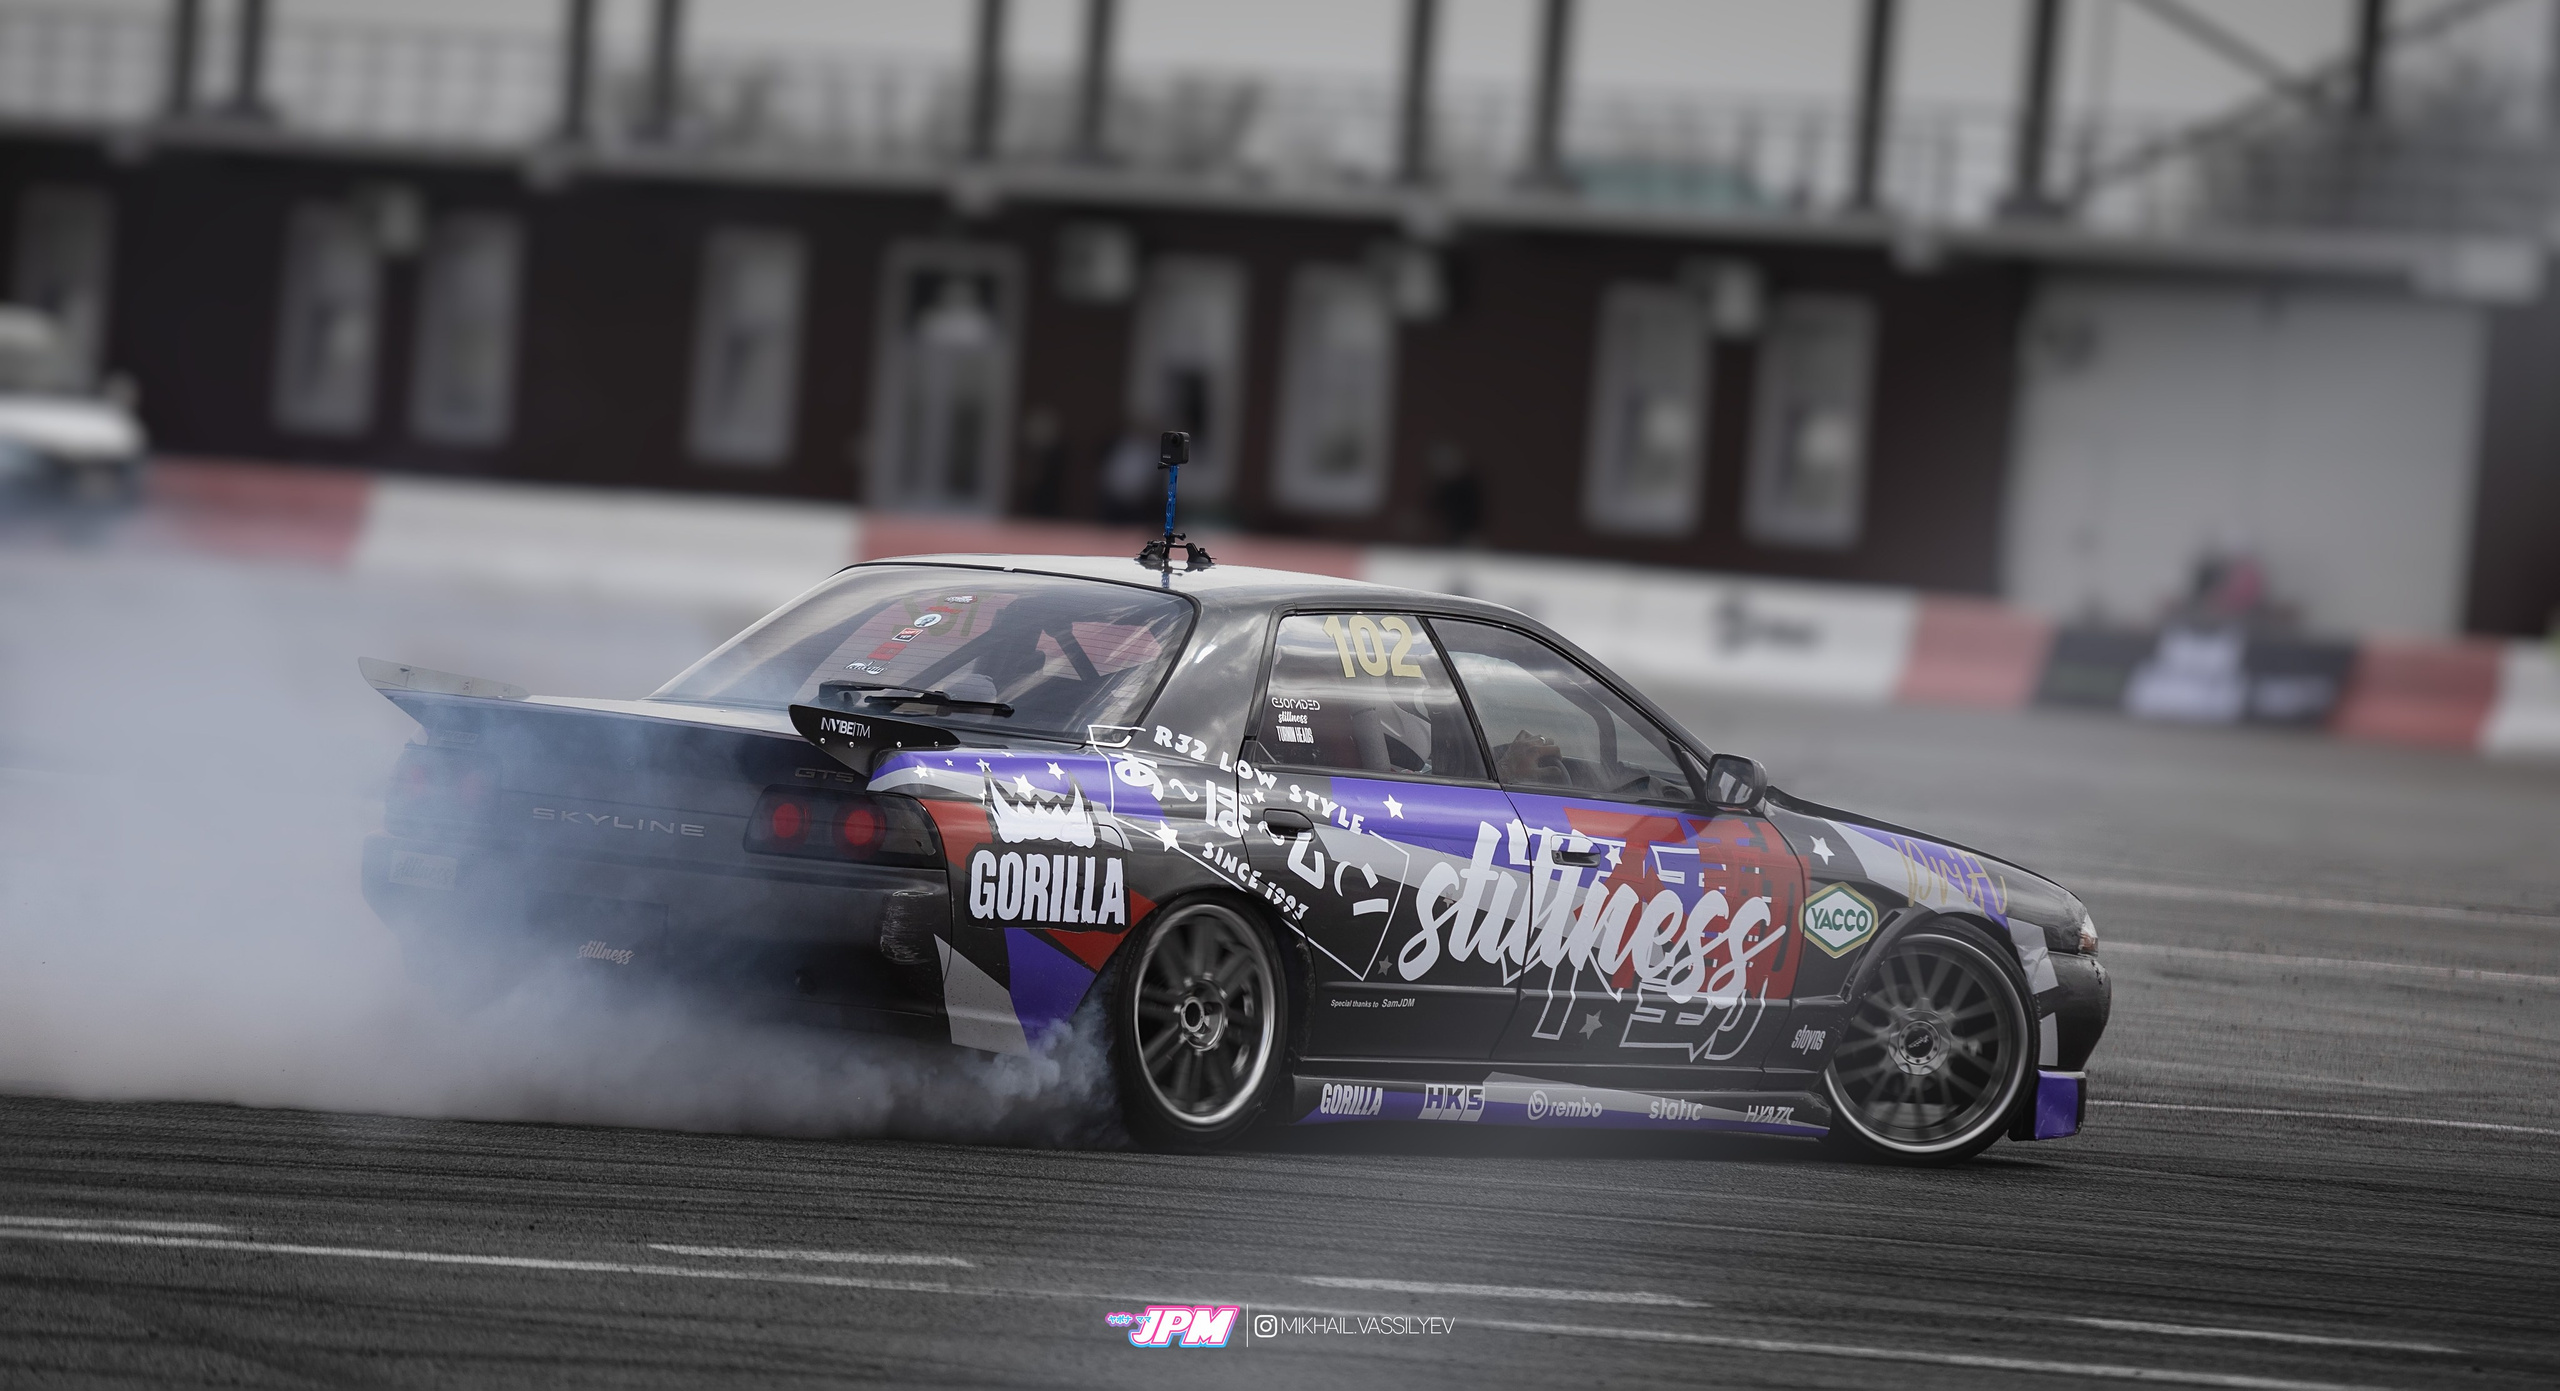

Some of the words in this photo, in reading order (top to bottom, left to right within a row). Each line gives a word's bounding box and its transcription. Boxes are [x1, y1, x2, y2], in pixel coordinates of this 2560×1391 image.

[1322, 615, 1423, 678] 102
[1278, 711, 1308, 724] stillness
[795, 767, 855, 783] GTS
[1153, 725, 1208, 761] R32
[1219, 751, 1278, 790] LOW
[1289, 784, 1365, 834] STYLE
[532, 806, 707, 838] SKYLINE
[969, 849, 1126, 926] GORILLA
[1202, 842, 1262, 889] SINCE
[1263, 881, 1310, 921] 1993
[1398, 818, 1787, 1010] stillness
[1810, 907, 1869, 932] YACCO
[576, 940, 635, 965] stillness
[1330, 999, 1352, 1008] Special
[1352, 1000, 1372, 1008] thanks
[1381, 998, 1416, 1008] SamJDM
[1320, 1083, 1383, 1115] GORILLA
[1424, 1085, 1485, 1114] HKS
[1648, 1097, 1704, 1121] static
